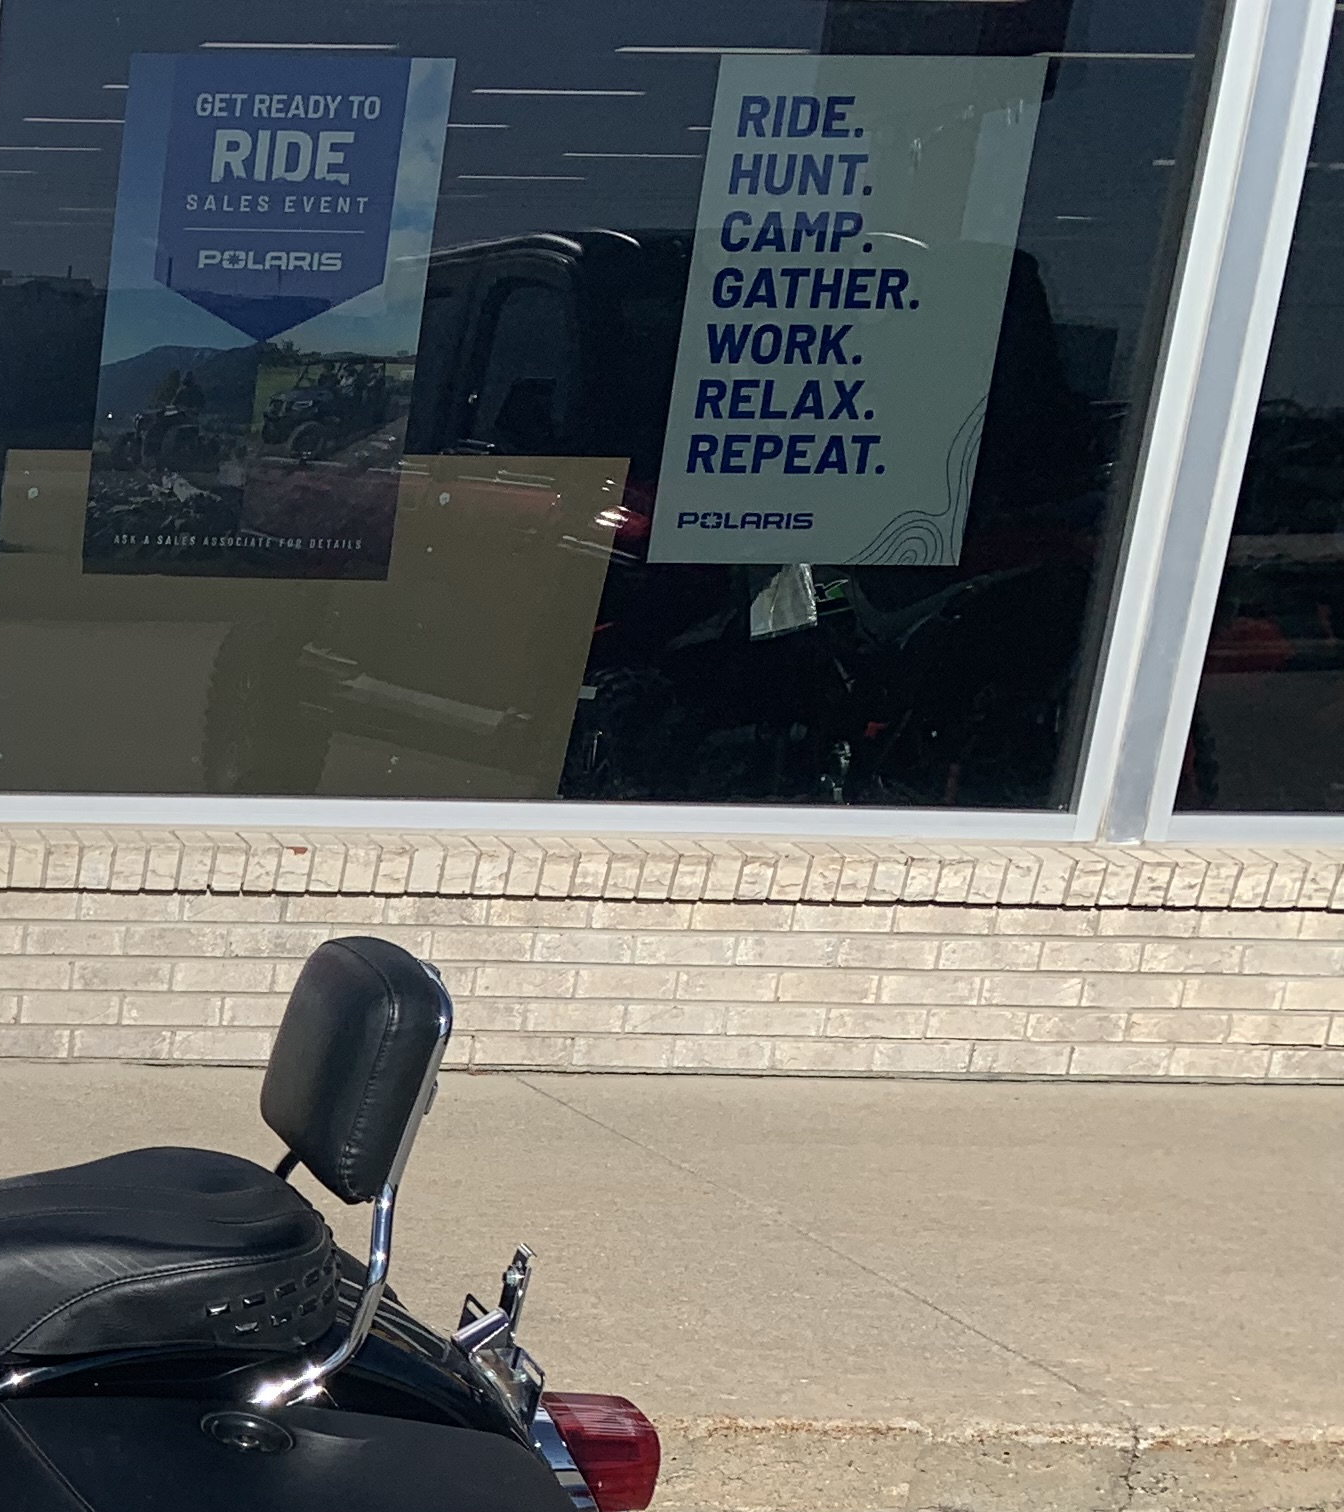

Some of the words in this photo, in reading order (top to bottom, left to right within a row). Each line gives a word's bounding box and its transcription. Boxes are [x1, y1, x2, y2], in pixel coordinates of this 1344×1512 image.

[195, 92, 247, 118] GET
[253, 93, 342, 119] READY
[349, 95, 382, 120] TO
[737, 95, 864, 138] RIDE.
[210, 128, 355, 186] RIDE
[727, 153, 872, 196] HUNT.
[186, 194, 270, 213] SALES
[284, 195, 369, 215] EVENT
[720, 210, 873, 253] CAMP.
[197, 249, 343, 271] POLARIS
[712, 267, 919, 310] GATHER.
[706, 323, 863, 365] WORK.
[694, 379, 875, 420] RELAX.
[685, 434, 886, 475] REPEAT.
[677, 512, 813, 529] POLARIS
[113, 534, 137, 545] ASK
[157, 535, 196, 546] SALES
[203, 536, 272, 548] ASSOCIATE
[309, 538, 362, 550] DETAILS
